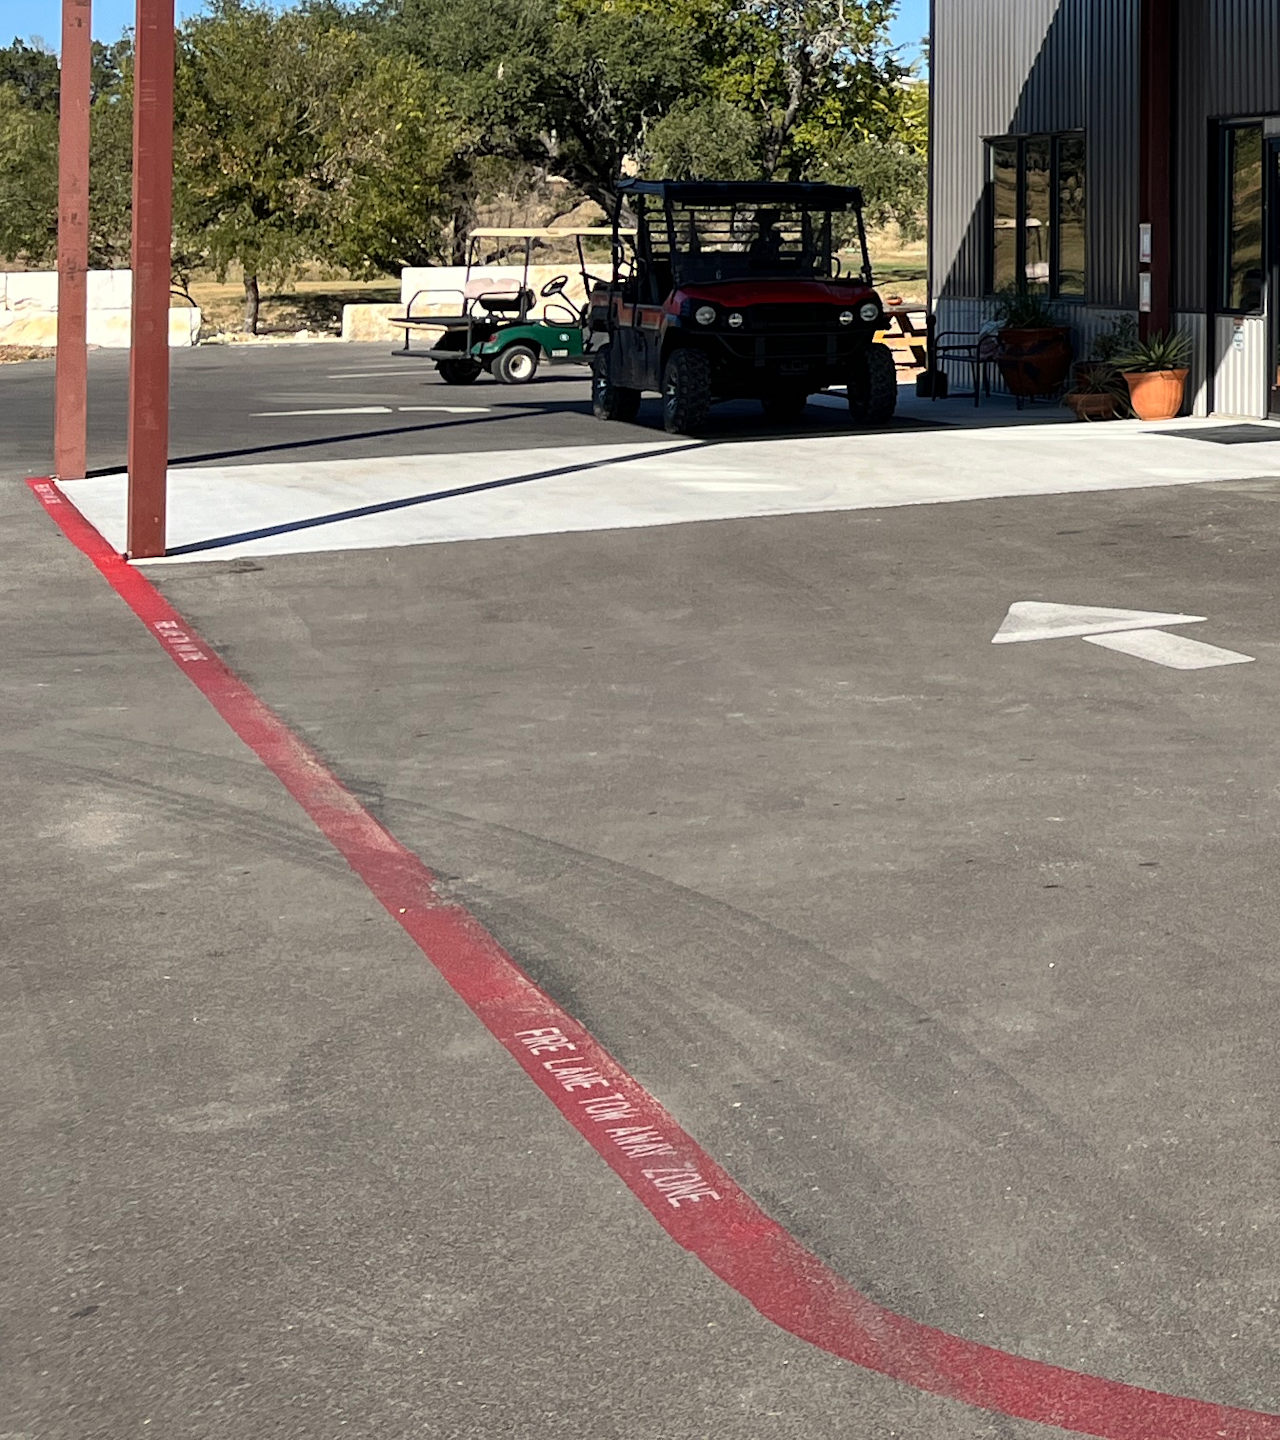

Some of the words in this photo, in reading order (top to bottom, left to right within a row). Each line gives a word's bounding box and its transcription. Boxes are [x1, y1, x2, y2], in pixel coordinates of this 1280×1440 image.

[514, 1026, 576, 1056] FIRE
[542, 1056, 610, 1092] LANE
[578, 1092, 642, 1122] TOW
[605, 1125, 678, 1159] AWAY
[640, 1160, 721, 1208] ZONE
